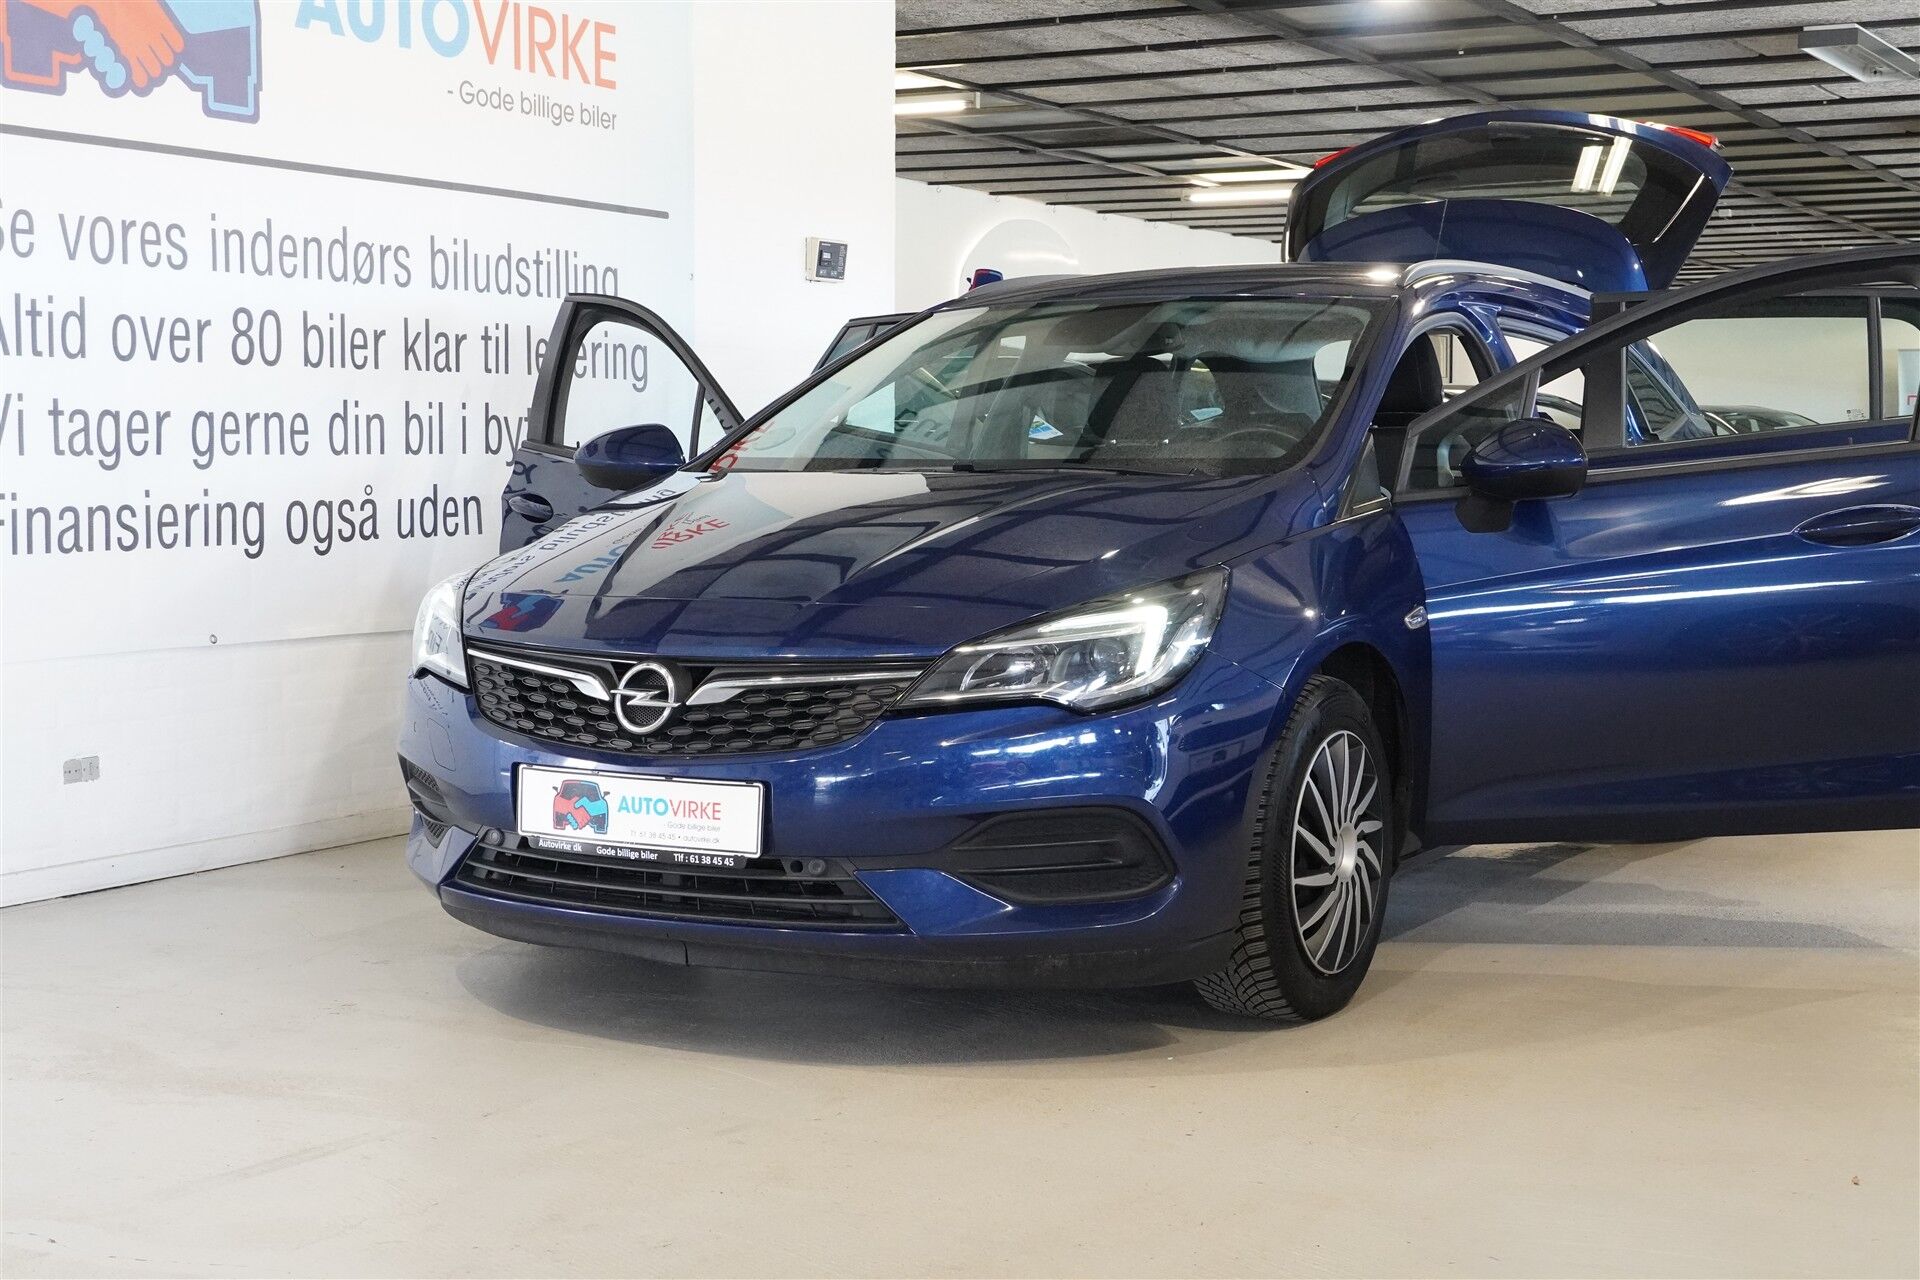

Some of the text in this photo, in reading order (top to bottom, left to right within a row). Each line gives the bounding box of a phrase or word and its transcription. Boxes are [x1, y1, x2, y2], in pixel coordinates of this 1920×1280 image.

[459, 80, 514, 112] Gode
[520, 91, 575, 126] billige
[580, 103, 617, 130] biler
[0, 198, 35, 258] e
[58, 213, 188, 271] vores
[210, 213, 412, 288] indendørs
[112, 313, 212, 364] over
[231, 306, 282, 367] 80
[302, 310, 387, 370] biler
[404, 317, 468, 373] klar
[481, 322, 509, 374] til
[526, 325, 648, 393] leering
[48, 398, 171, 471] tager
[191, 410, 309, 470] gerne
[328, 399, 385, 456] din
[405, 400, 444, 456] bil
[461, 402, 467, 455] i
[0, 484, 483, 559] inansiering også uden
[618, 795, 721, 821] AUTOVIRKE
[538, 840, 572, 851] Autovirke
[596, 846, 658, 860] Gode billige biler
[673, 853, 684, 863] Tlf
[689, 855, 699, 864] 61
[701, 856, 711, 865] 38
[712, 857, 722, 866] 45
[723, 858, 734, 867] 45
